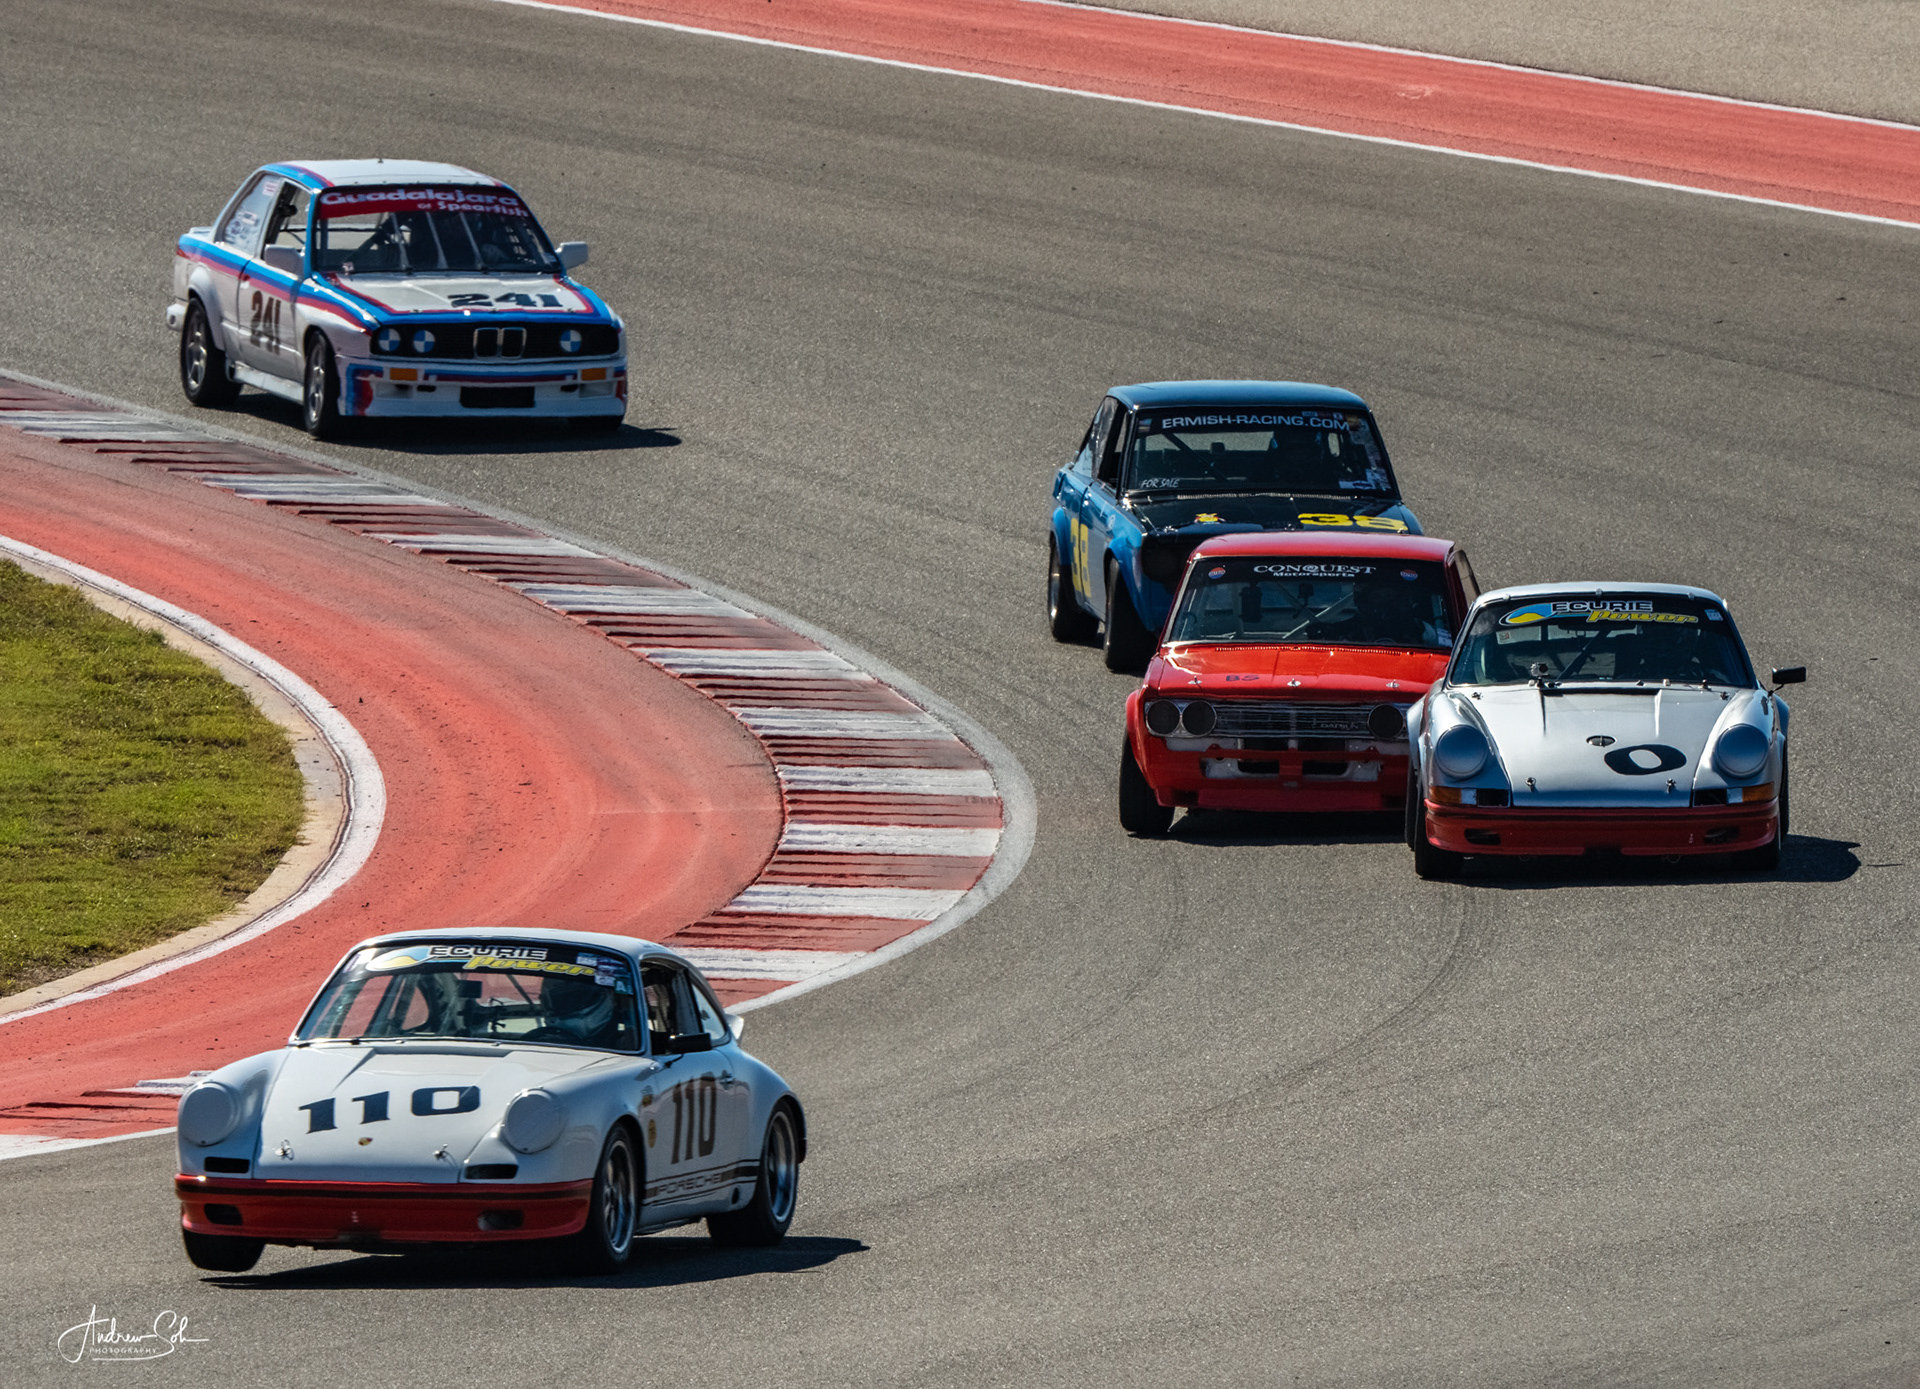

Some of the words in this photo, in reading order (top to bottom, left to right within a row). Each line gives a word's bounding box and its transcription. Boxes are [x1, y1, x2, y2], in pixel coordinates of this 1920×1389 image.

[319, 189, 519, 206] Guadalajara
[437, 201, 529, 217] Spearfish
[448, 293, 563, 308] 241
[250, 290, 282, 355] 241
[1162, 415, 1350, 431] ERMISH-RACING.COM
[1140, 480, 1158, 488] FOR
[1159, 479, 1180, 488] SALE
[1298, 513, 1409, 531] 38
[1070, 517, 1092, 598] 38
[1253, 564, 1376, 575] CONQUEST
[1551, 601, 1653, 613] ECURIE
[1586, 610, 1698, 623] Power
[430, 946, 548, 959] ECURIE
[463, 956, 598, 976] Power
[298, 1085, 481, 1134] 110
[671, 1071, 717, 1165] 110
[657, 1173, 722, 1194] PORSCHE
